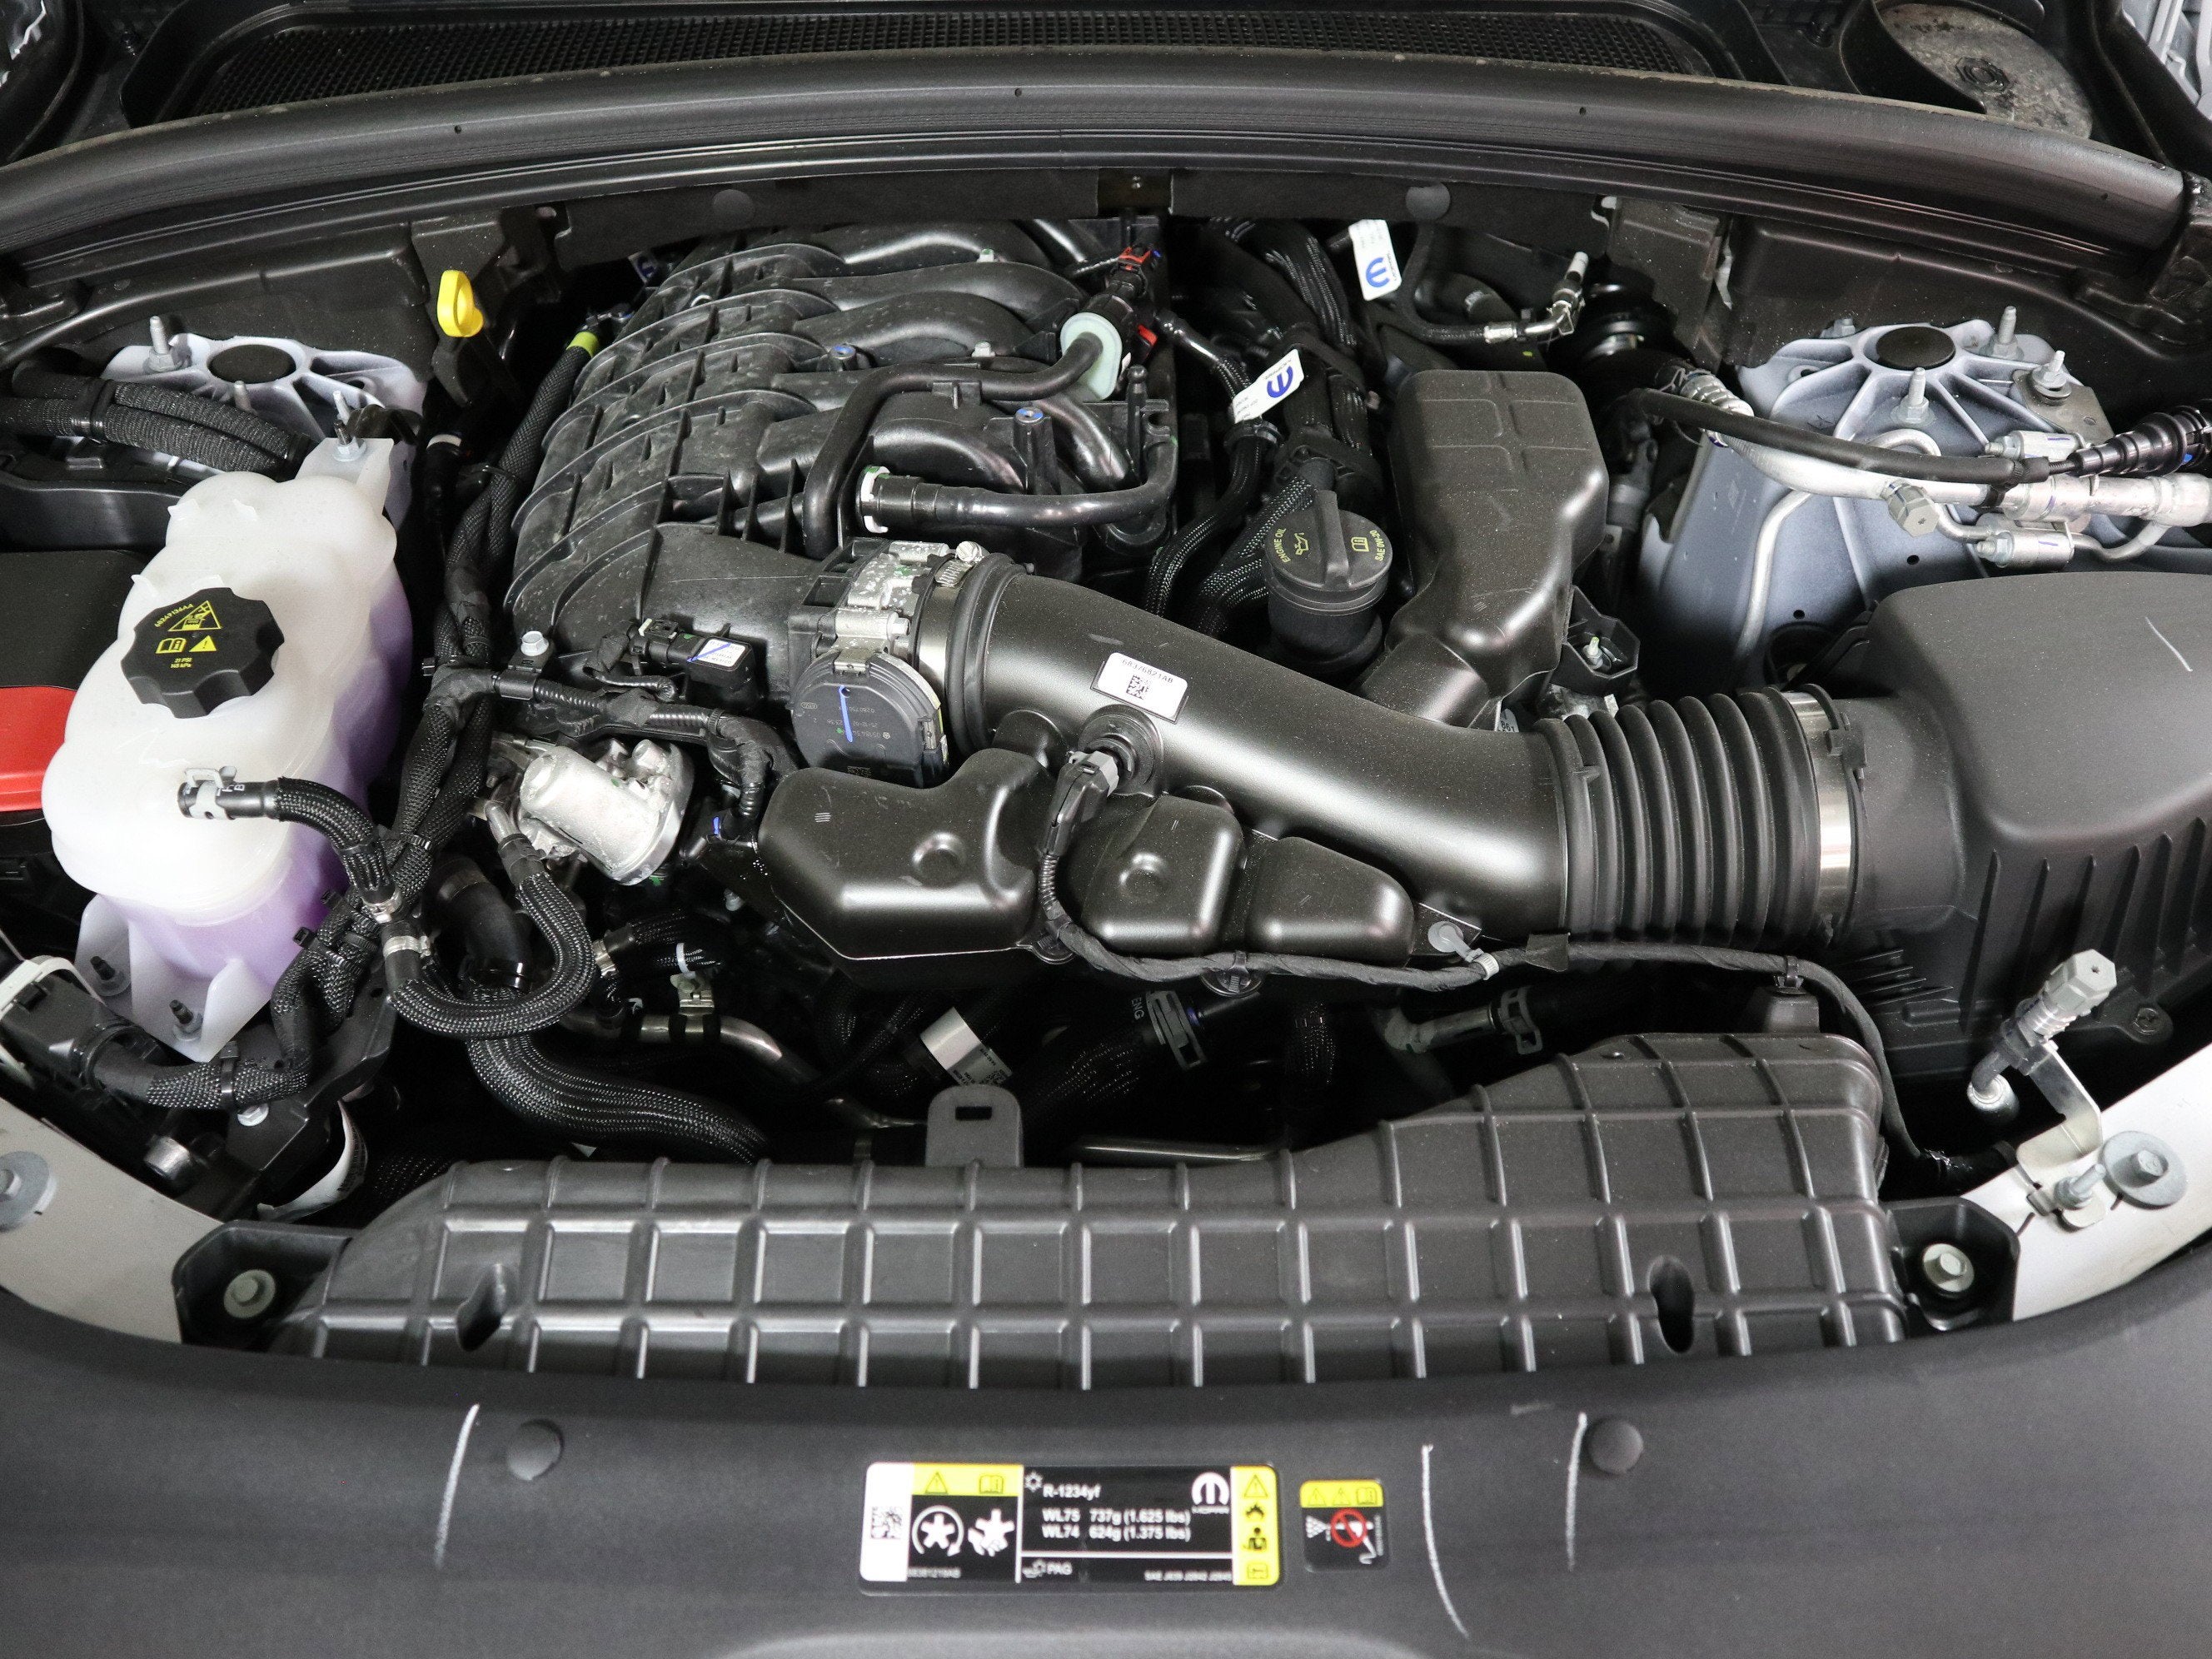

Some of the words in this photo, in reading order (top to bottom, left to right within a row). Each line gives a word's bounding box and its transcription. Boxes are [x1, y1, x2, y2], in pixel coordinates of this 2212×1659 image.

[1275, 528, 1287, 537] OIL
[1369, 530, 1385, 548] 0W-20
[1273, 538, 1292, 563] ENGINE
[1375, 547, 1386, 561] SAE
[1121, 659, 1174, 685] 68376821AB
[1131, 997, 1145, 1020] ENG
[1043, 1483, 1102, 1501] R-1234yf
[1043, 1507, 1080, 1522] WL75
[1089, 1507, 1122, 1525] 737g
[1124, 1508, 1163, 1526] (1.625
[1165, 1508, 1191, 1527] lbs)
[1042, 1523, 1080, 1538] WL74
[1089, 1524, 1122, 1542] 624g
[1124, 1525, 1163, 1542] (1.375
[1165, 1525, 1191, 1542] lbs)
[1047, 1562, 1074, 1576] PAG
